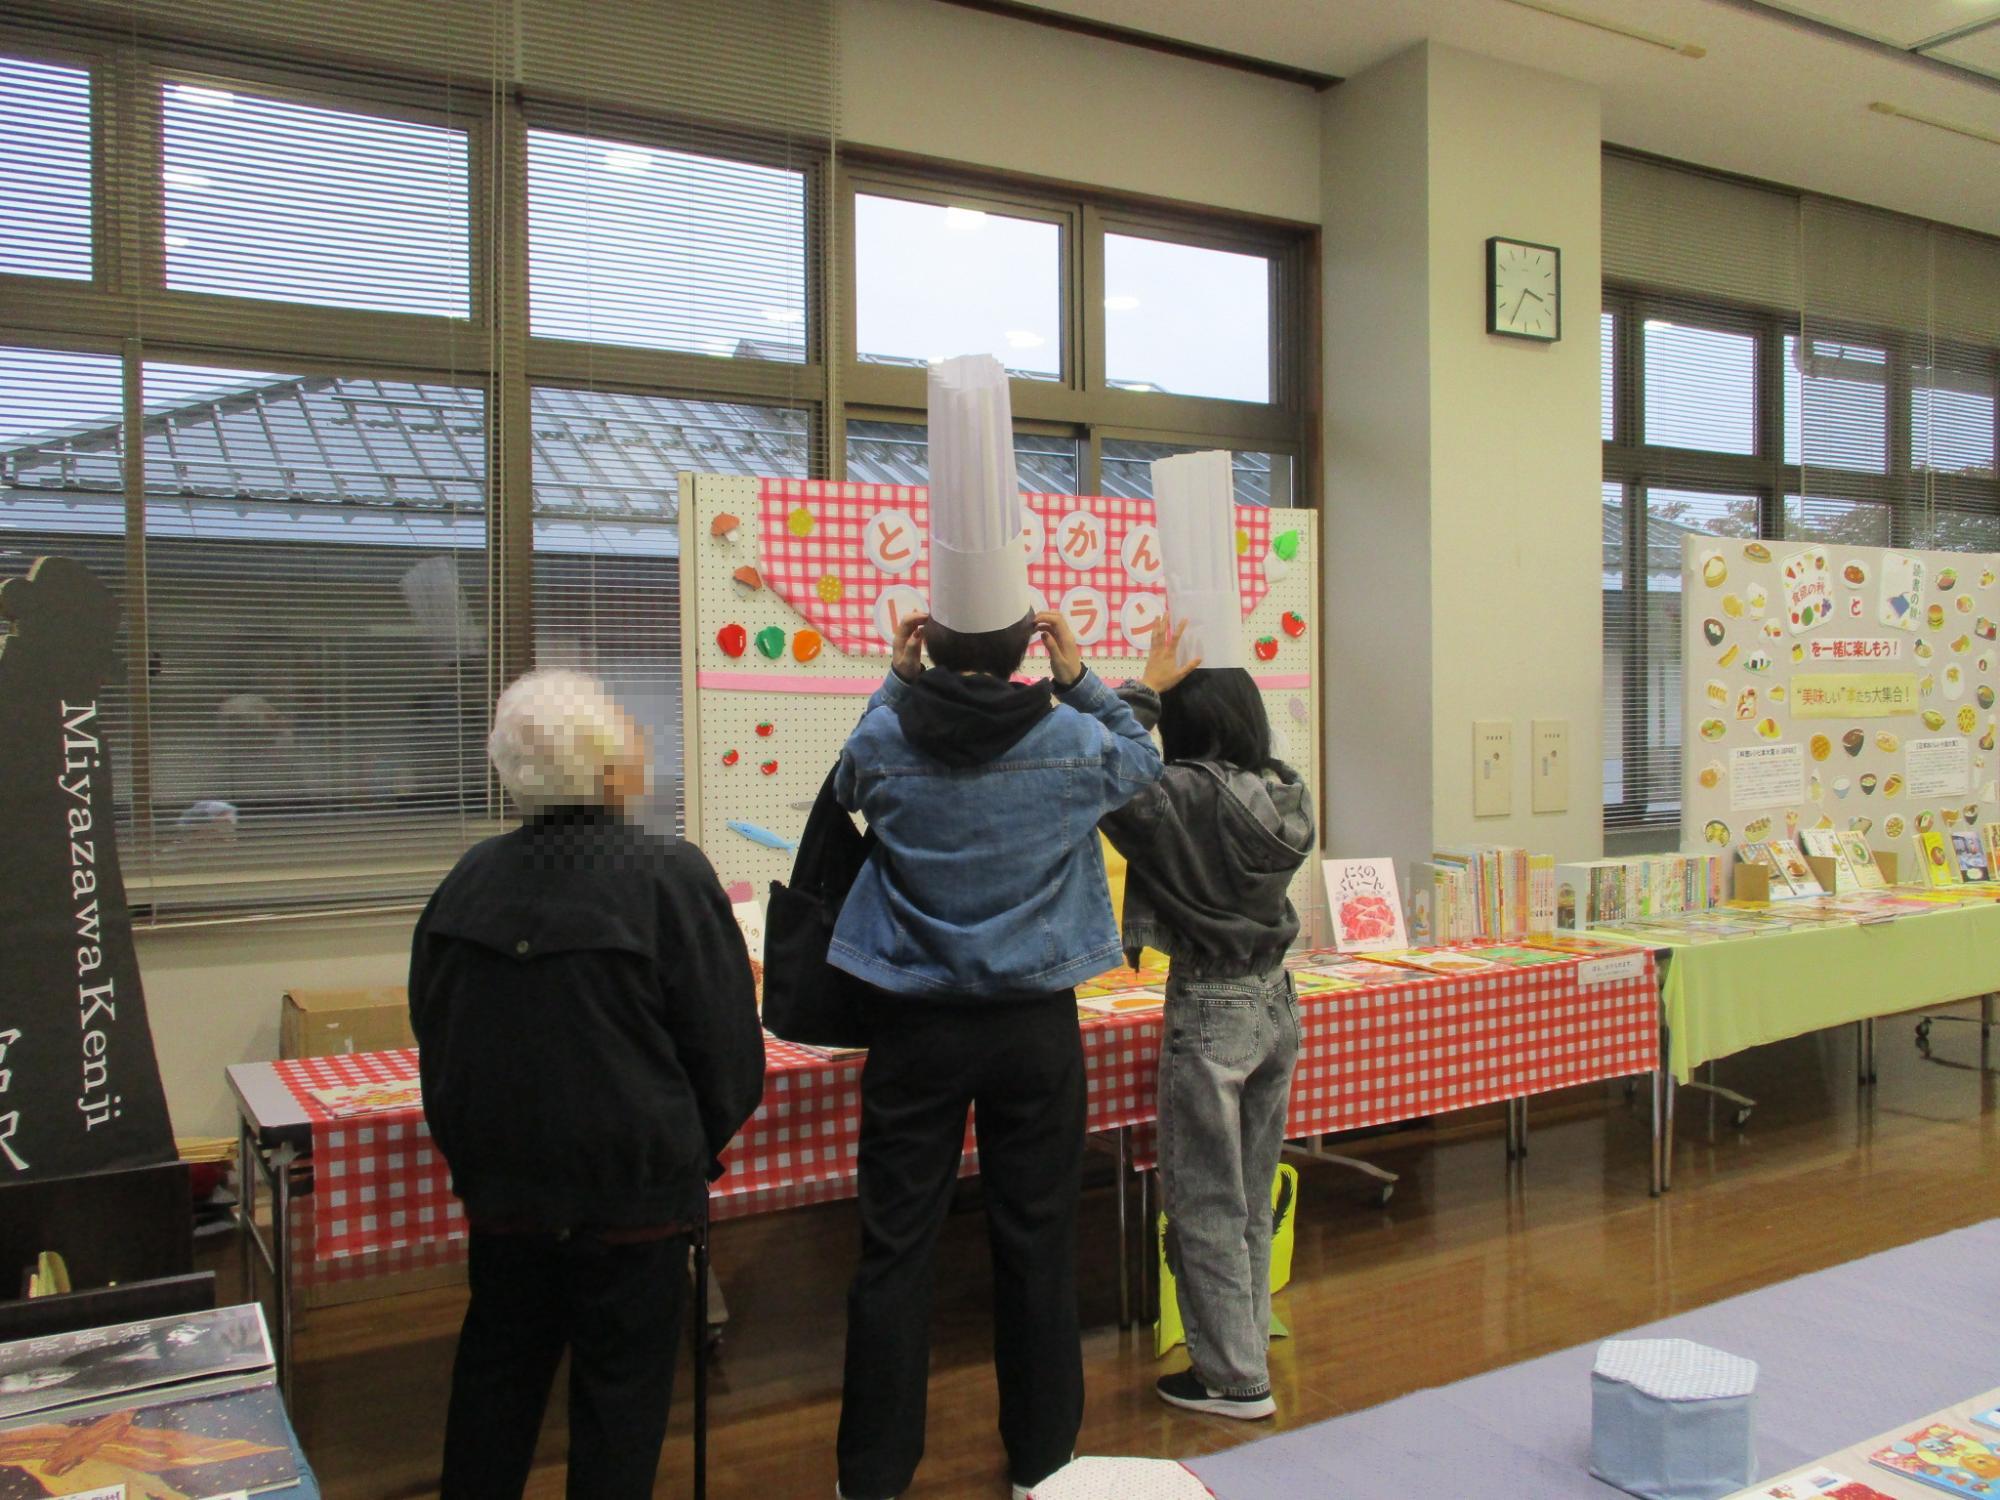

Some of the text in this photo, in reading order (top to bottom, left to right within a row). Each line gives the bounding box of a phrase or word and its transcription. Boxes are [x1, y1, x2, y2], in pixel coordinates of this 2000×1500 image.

[1851, 599, 1861, 616] と
[1344, 866, 1376, 879] にくの
